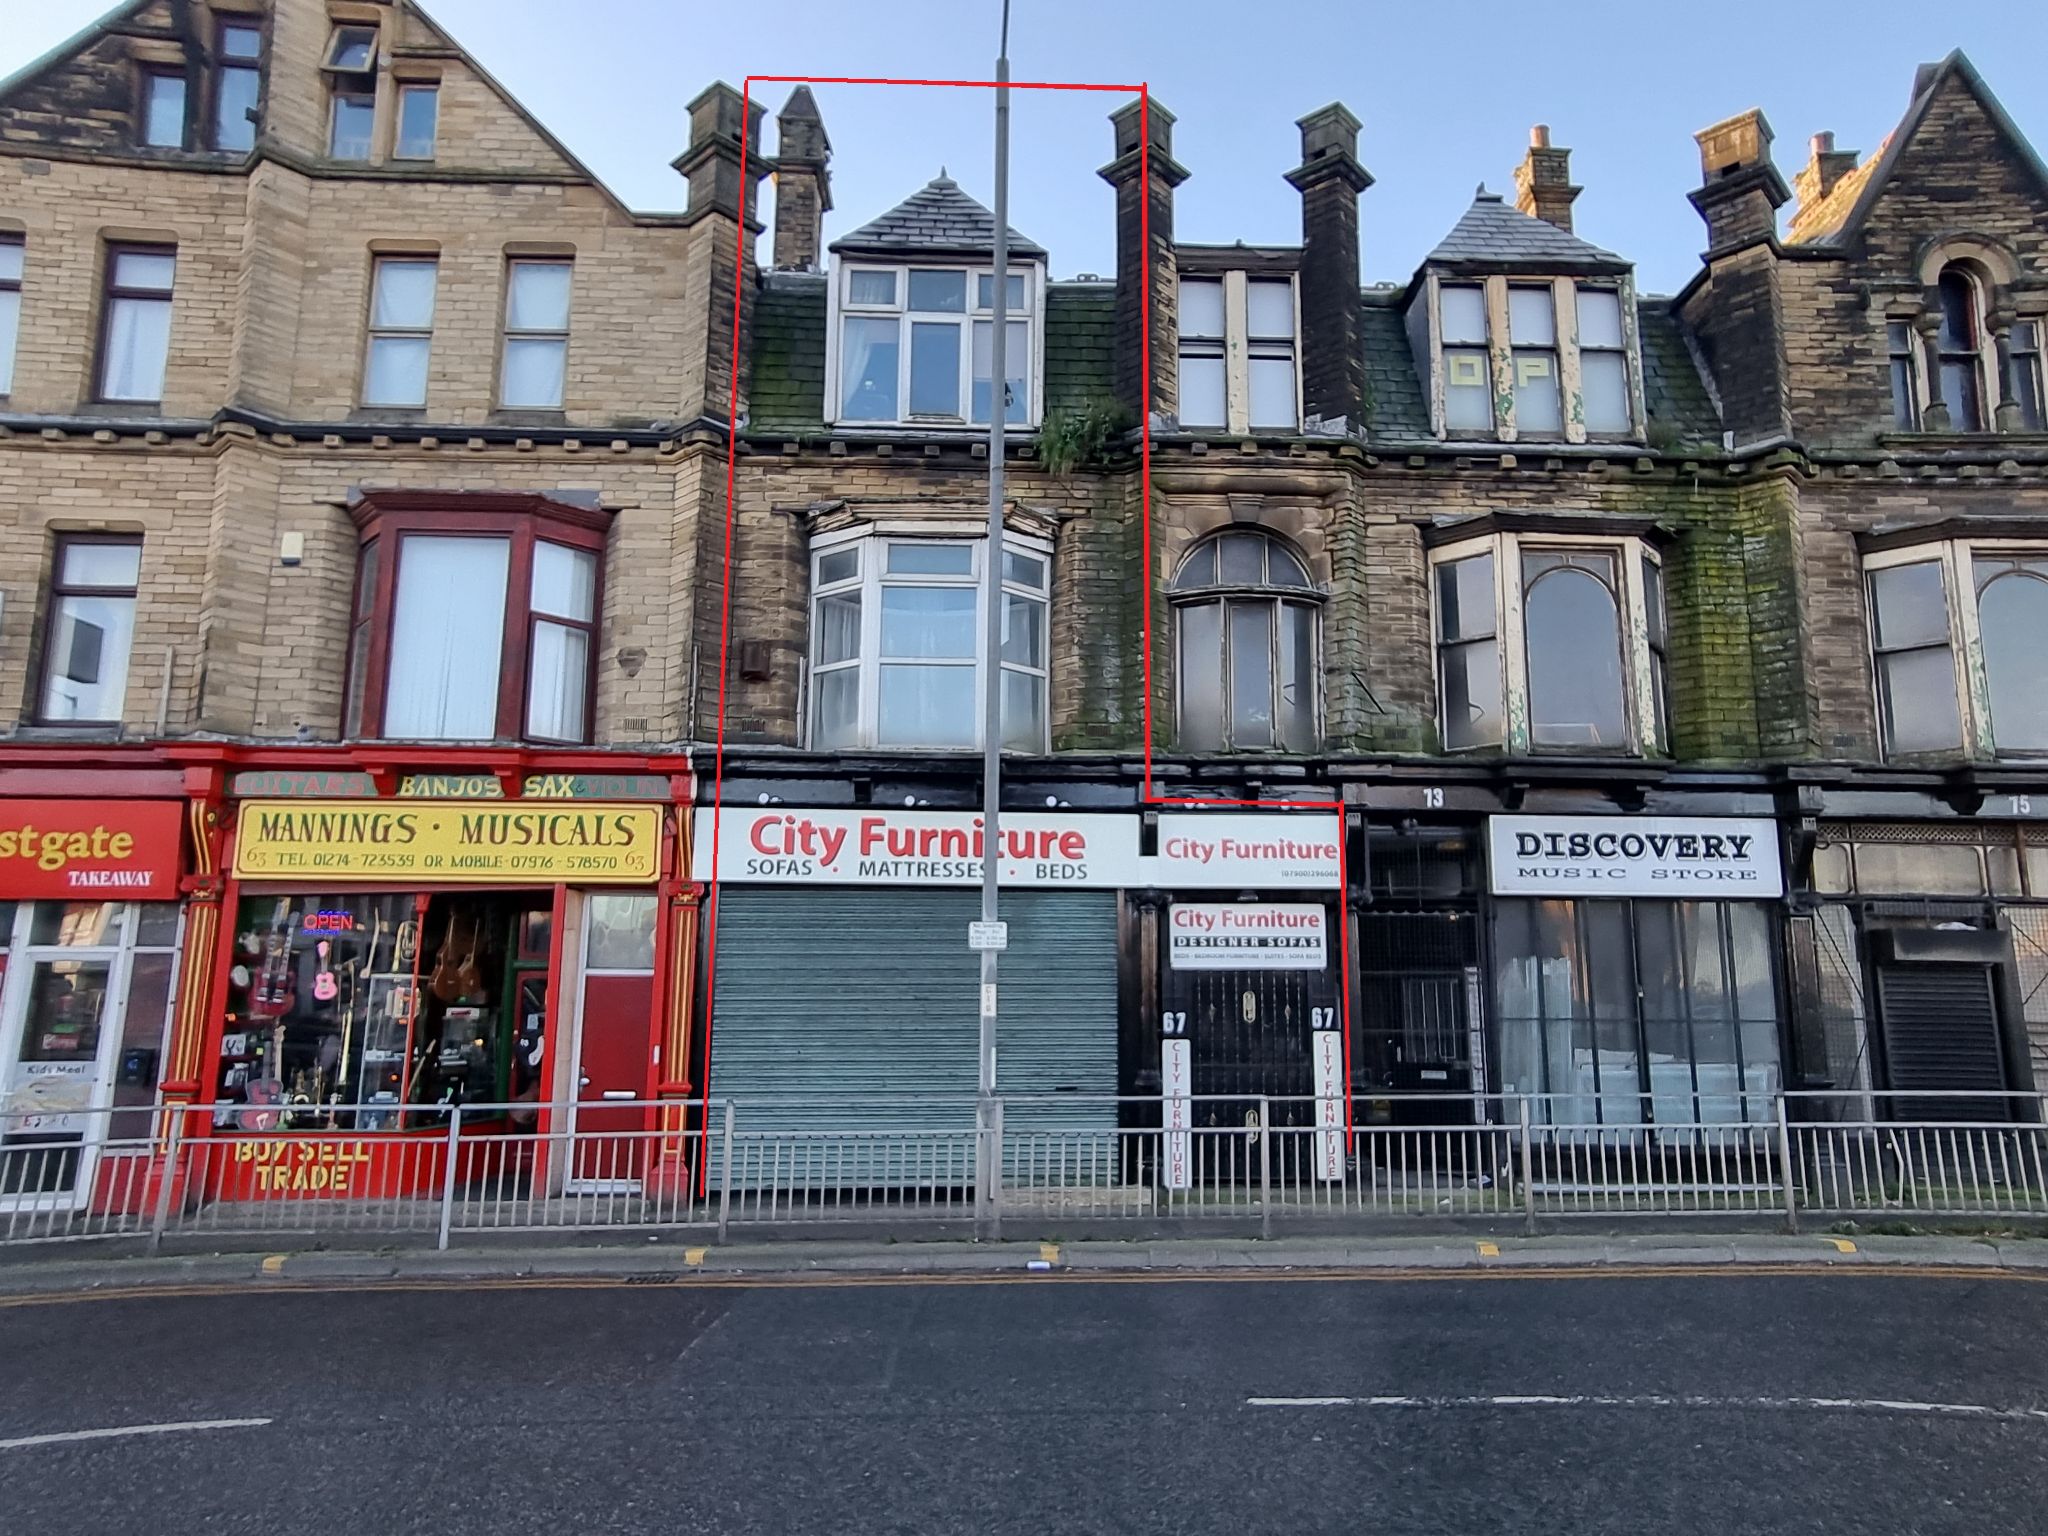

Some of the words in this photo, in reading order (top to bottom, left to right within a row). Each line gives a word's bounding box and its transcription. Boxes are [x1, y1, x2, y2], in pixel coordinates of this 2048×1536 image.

[400, 776, 501, 796] BANJOS
[525, 775, 575, 797] SAX
[258, 812, 418, 844] MANNINGS
[458, 814, 636, 846] MUSICALS
[750, 815, 848, 867] City
[1166, 838, 1215, 864] City
[1221, 838, 1338, 860] Furniture
[1515, 831, 1754, 862] DISCOVERY
[276, 853, 307, 866] TEL
[424, 855, 443, 867] OR
[747, 859, 812, 876] SOFAS
[1036, 864, 1087, 880] BEDS
[68, 871, 153, 887] TAKEAWAY
[1517, 867, 1626, 879] MUSIC
[1650, 868, 1757, 880] STORE
[304, 913, 353, 930] OPEN
[1174, 909, 1216, 932] City
[1221, 910, 1320, 928] Furniture
[1176, 936, 1259, 947] DESIGNER
[1267, 936, 1318, 947] SOFAS
[1162, 1012, 1187, 1034] 67
[1311, 1007, 1334, 1029] 67
[1172, 1042, 1181, 1083] CITY
[1322, 1034, 1332, 1076] CITY
[56, 1065, 85, 1074] Meal
[234, 1141, 287, 1162] BUY
[297, 1141, 369, 1162] SELL
[256, 1165, 349, 1190] TRADE
